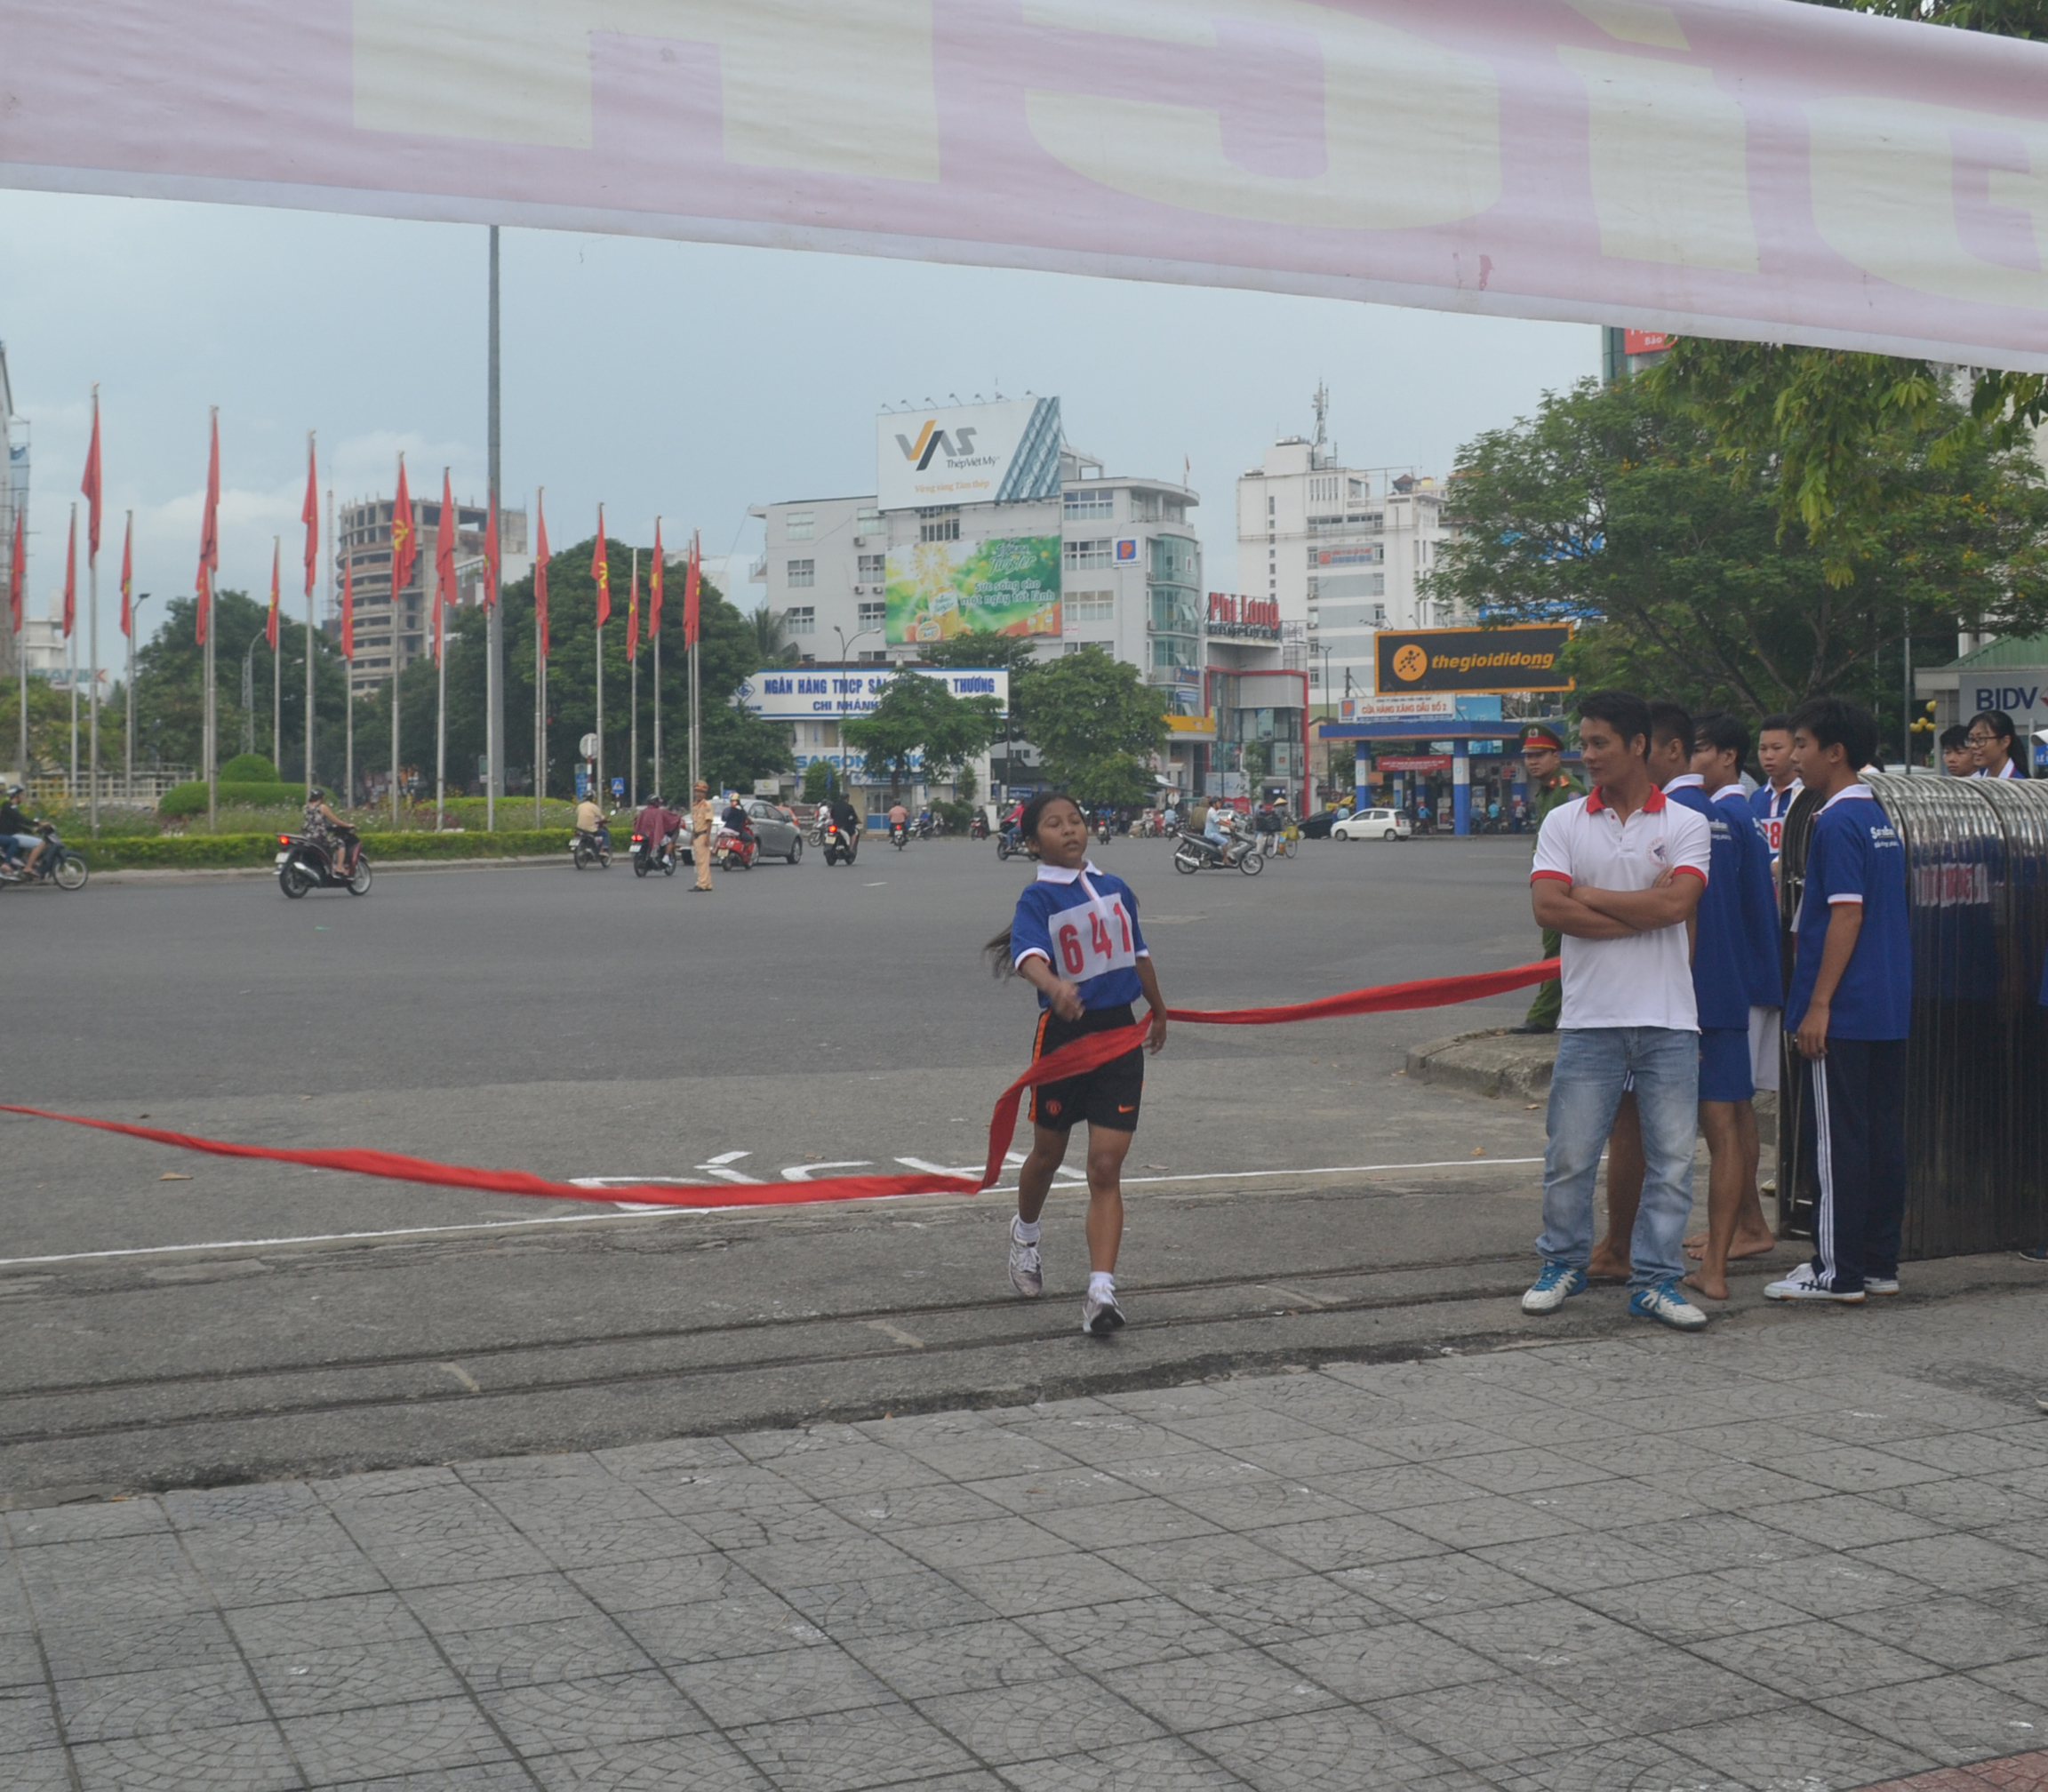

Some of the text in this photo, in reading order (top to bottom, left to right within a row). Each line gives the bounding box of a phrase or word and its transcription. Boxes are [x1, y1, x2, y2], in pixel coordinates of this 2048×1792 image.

[895, 420, 977, 471] VAS
[988, 555, 1036, 576] Twister
[975, 578, 1041, 592] Sức sống cho
[984, 592, 1011, 606] ngày
[1031, 589, 1055, 602] lành
[1209, 592, 1280, 629] Phi Long
[1432, 652, 1555, 673] thegioididong
[764, 676, 793, 694] NGÂN
[798, 676, 827, 694] HÀNG
[833, 679, 863, 694] TMCP
[953, 676, 995, 693] THƯƠNG
[812, 698, 879, 711] CHI NHÁNH
[1376, 702, 1394, 714] HÀNG
[1396, 701, 1414, 713] XĂNG
[1443, 703, 1447, 711] 2
[1976, 686, 2038, 710] BIDV
[1059, 902, 1132, 975] 641
